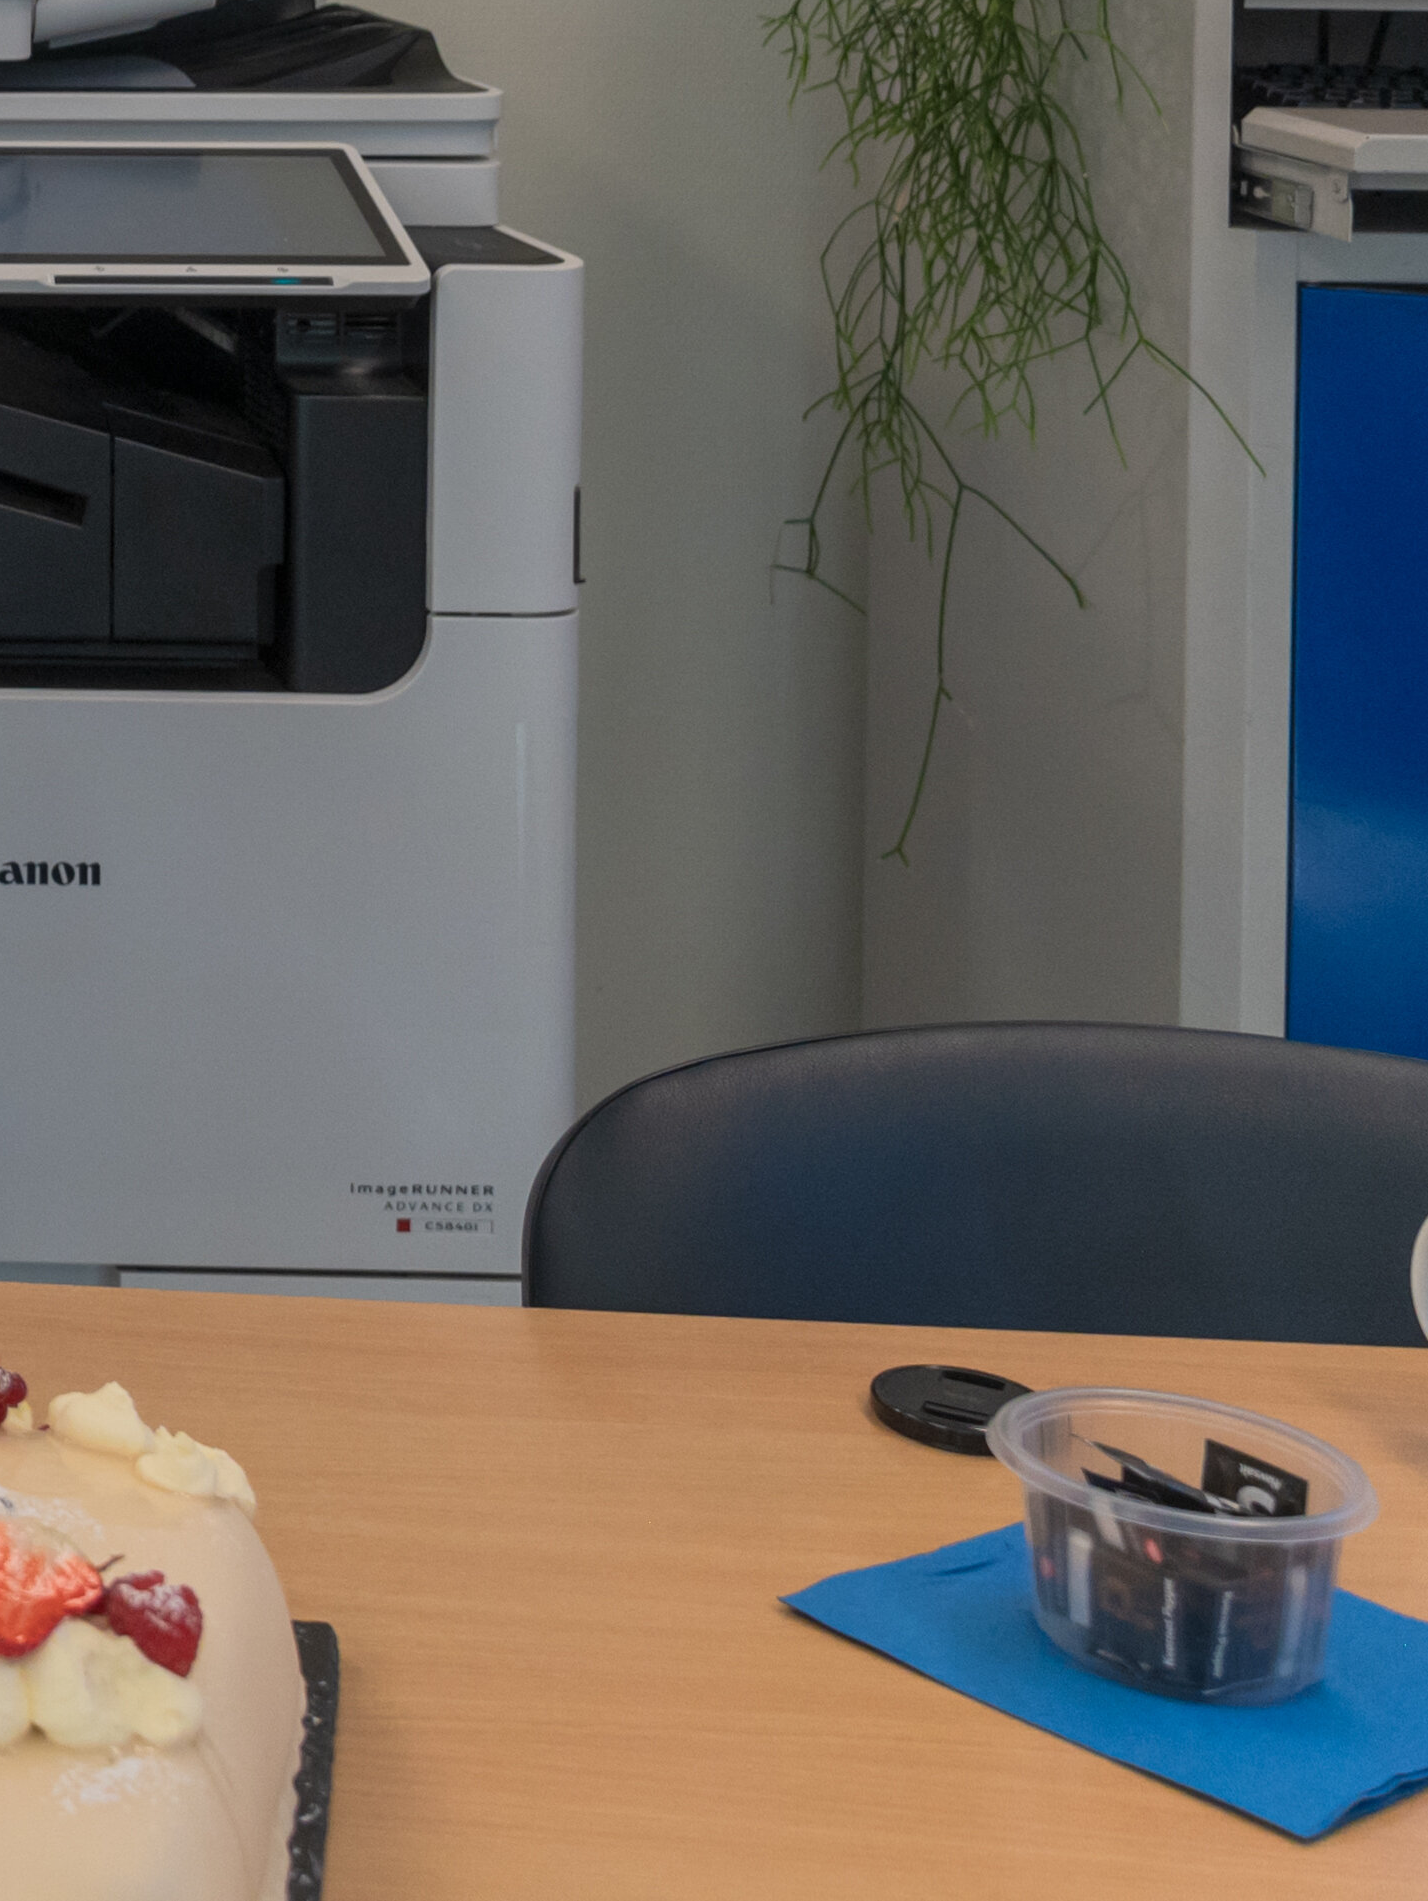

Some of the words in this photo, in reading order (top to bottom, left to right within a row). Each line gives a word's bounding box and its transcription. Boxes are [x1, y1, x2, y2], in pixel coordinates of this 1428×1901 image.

[350, 1183, 494, 1196] imageRUNNER
[384, 1201, 464, 1212] ADVANCE
[472, 1201, 493, 1213] DX
